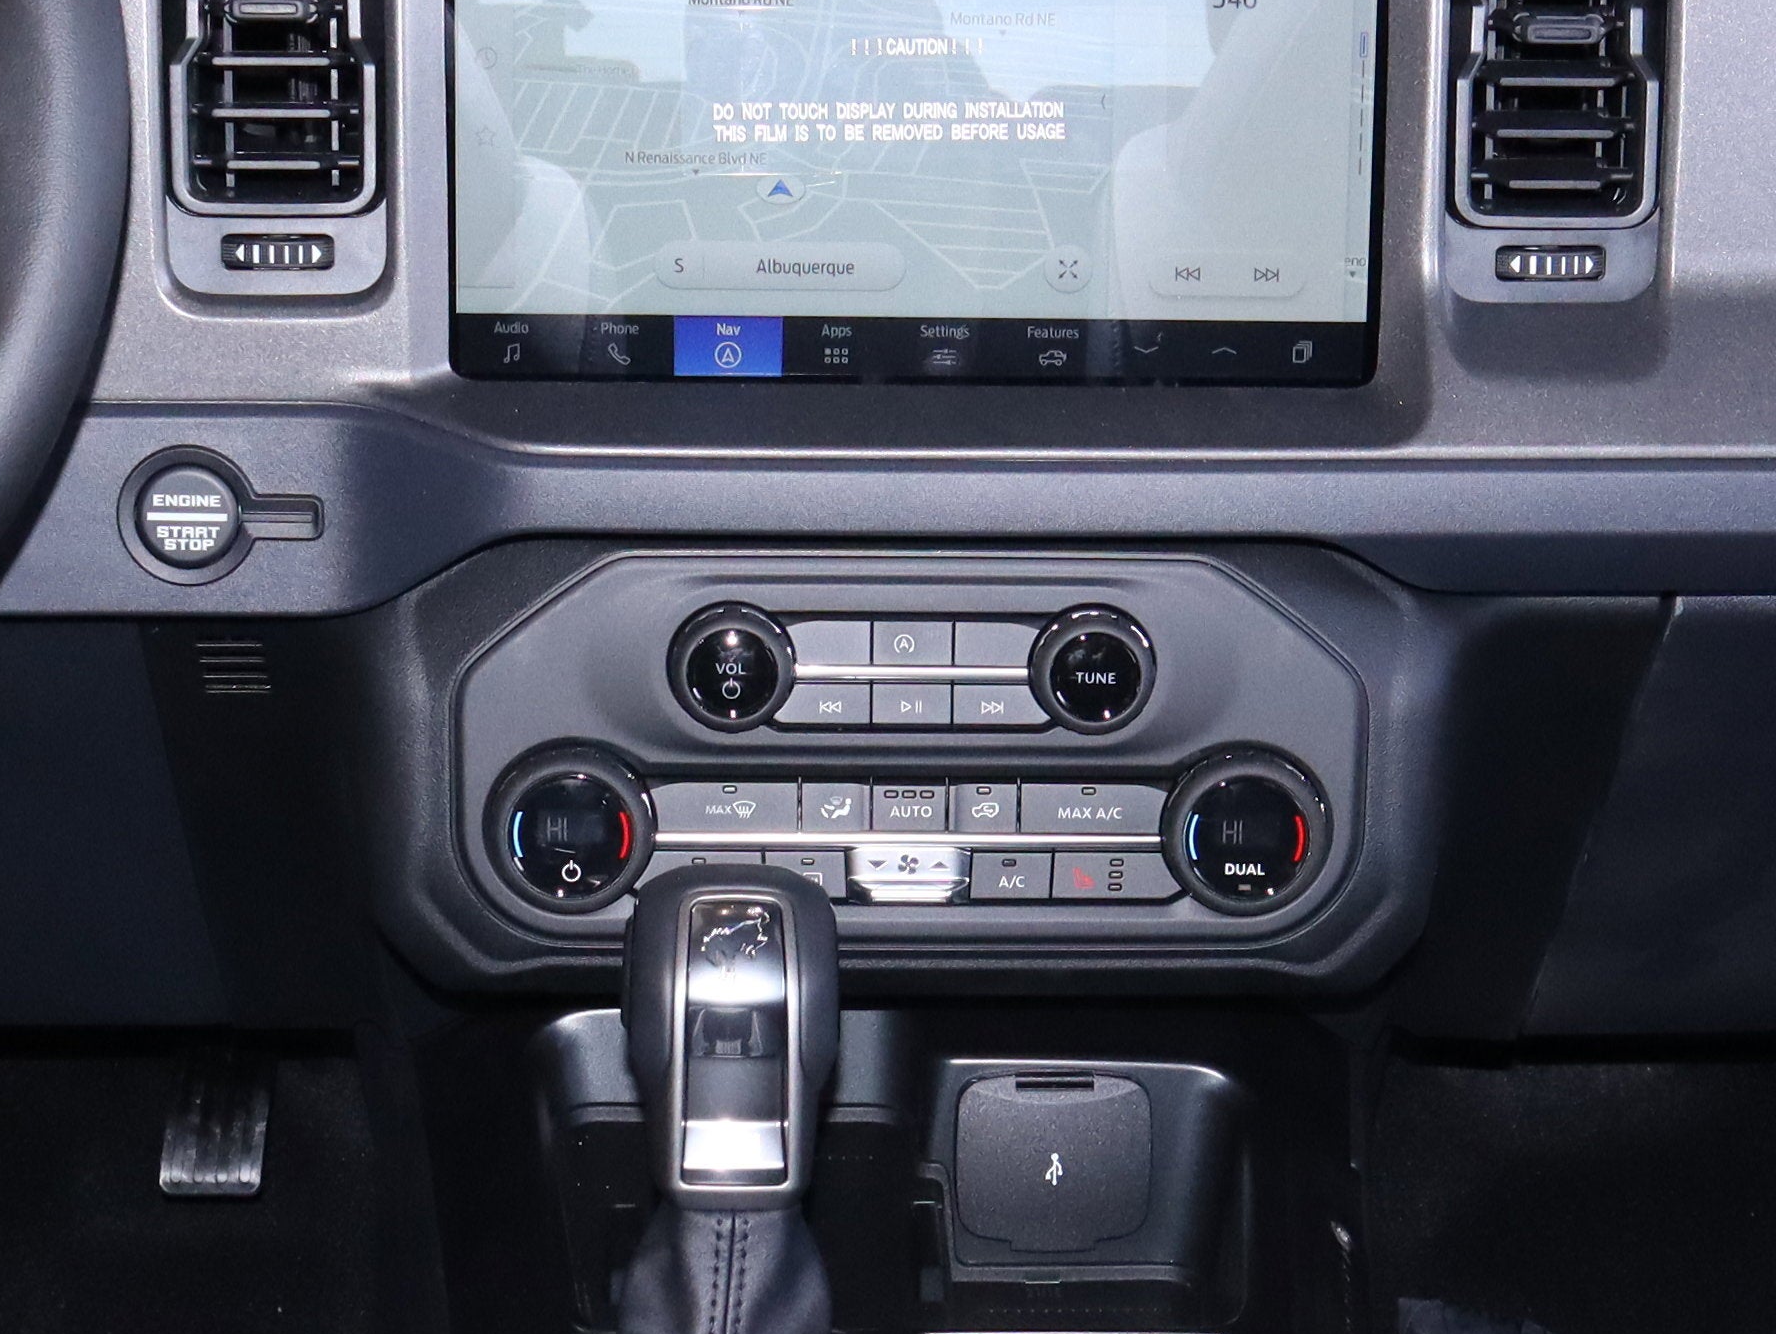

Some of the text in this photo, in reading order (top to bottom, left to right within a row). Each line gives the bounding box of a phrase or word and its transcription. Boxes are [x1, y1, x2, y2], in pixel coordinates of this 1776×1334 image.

[950, 12, 1056, 27] Montano Rd NE
[712, 101, 1064, 121] DO NOT TOUCH DISPLAY DURING INSTALLATION
[713, 123, 1066, 143] THIS FILM IS TO BE REMOVED BEFORE USAGE
[625, 151, 767, 166] N Renaissance Blvd NE
[674, 258, 684, 274] S
[756, 258, 856, 278] Albuquerque
[494, 321, 530, 335] Audio
[600, 322, 640, 336] Phone
[716, 323, 742, 337] Nav
[821, 324, 853, 340] Apps
[920, 325, 971, 340] Settings
[1026, 326, 1080, 340] Features
[152, 493, 222, 508] ENGINE
[156, 525, 220, 539] START
[163, 537, 216, 552] STOP
[715, 662, 747, 676] VOL
[1074, 670, 1117, 685] TUNE
[705, 804, 732, 816] MAX
[889, 804, 933, 819] AUTO
[1057, 805, 1123, 821] MAX A/C
[1224, 862, 1266, 877] DUAL
[998, 874, 1026, 889] A/C
